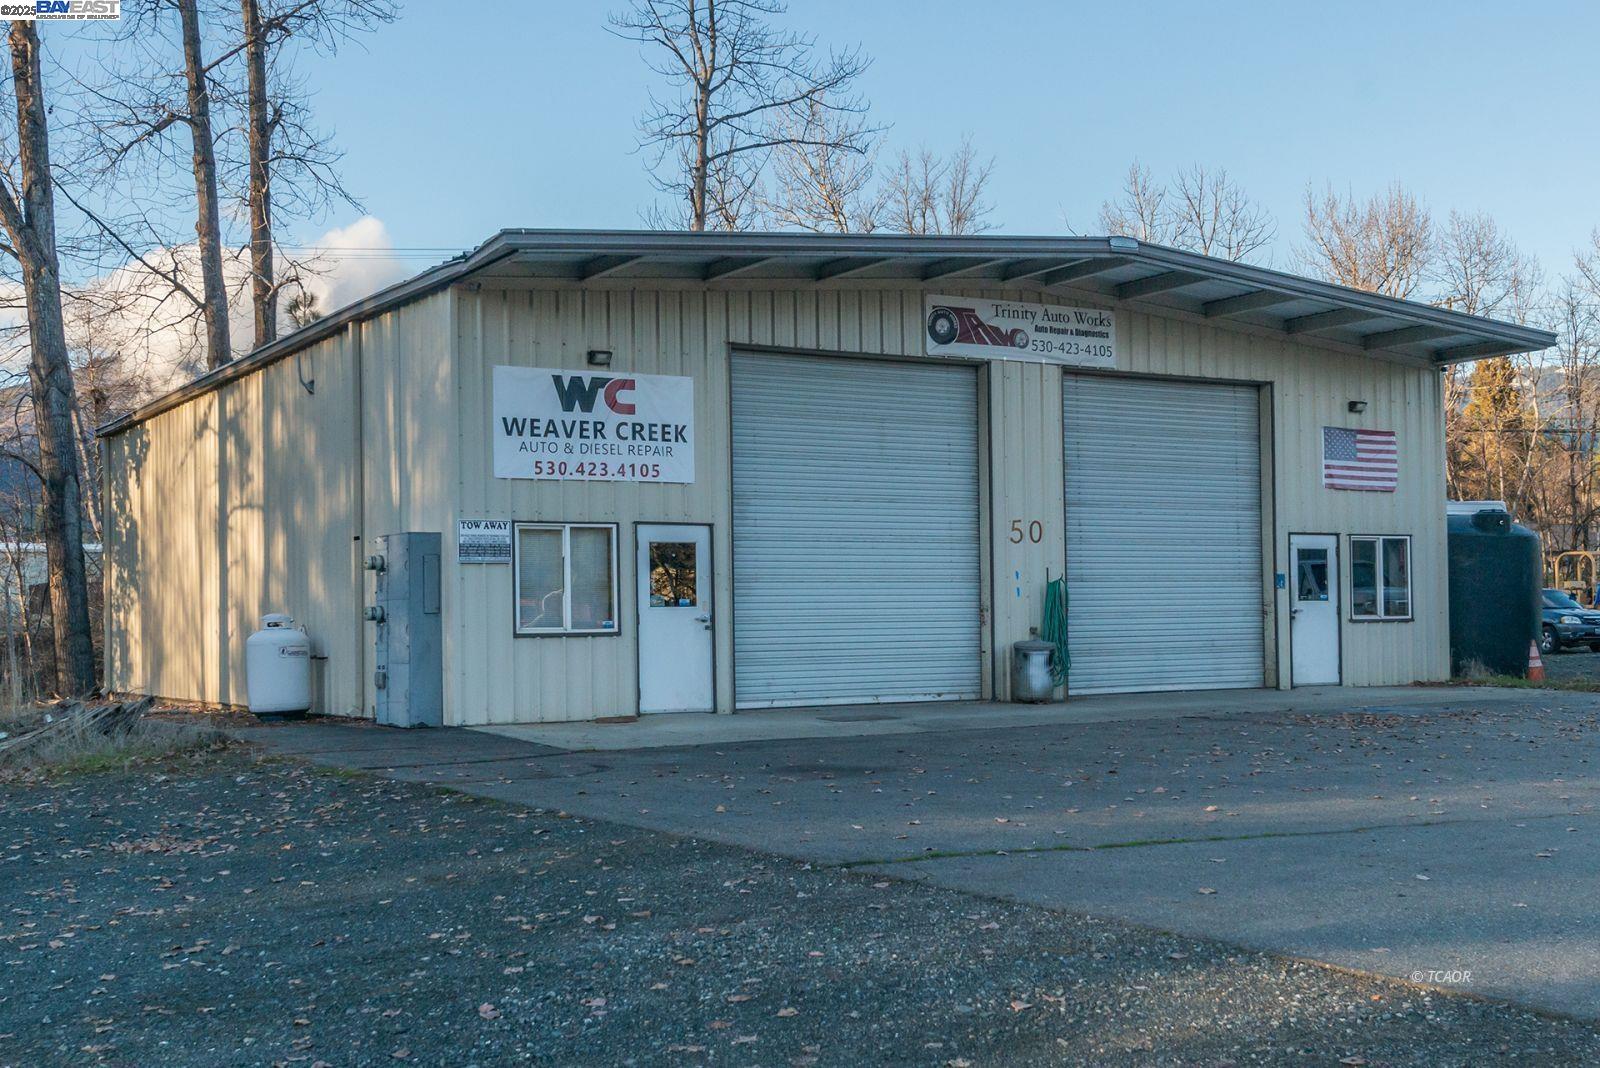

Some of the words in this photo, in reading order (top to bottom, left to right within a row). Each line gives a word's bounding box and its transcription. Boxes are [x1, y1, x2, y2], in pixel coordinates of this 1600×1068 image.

[992, 303, 1037, 325] Trinity
[1041, 308, 1070, 324] Auto
[1074, 311, 1112, 328] Works
[1034, 324, 1049, 334] Auto
[1049, 326, 1069, 336] Repair
[1075, 328, 1110, 339] Diagnostics
[1031, 339, 1113, 358] 530-423-4105
[551, 374, 636, 416] WC
[502, 417, 607, 440] WEAVER
[615, 421, 688, 444] CREEK
[519, 441, 559, 454] AUTO
[563, 442, 575, 455] &
[579, 443, 623, 456] DIESEL
[628, 445, 674, 457] REPAIR
[534, 460, 661, 478] 530.423.4105
[460, 521, 481, 530] TOW
[483, 521, 508, 530] AWAY
[1010, 519, 1042, 544] 50
